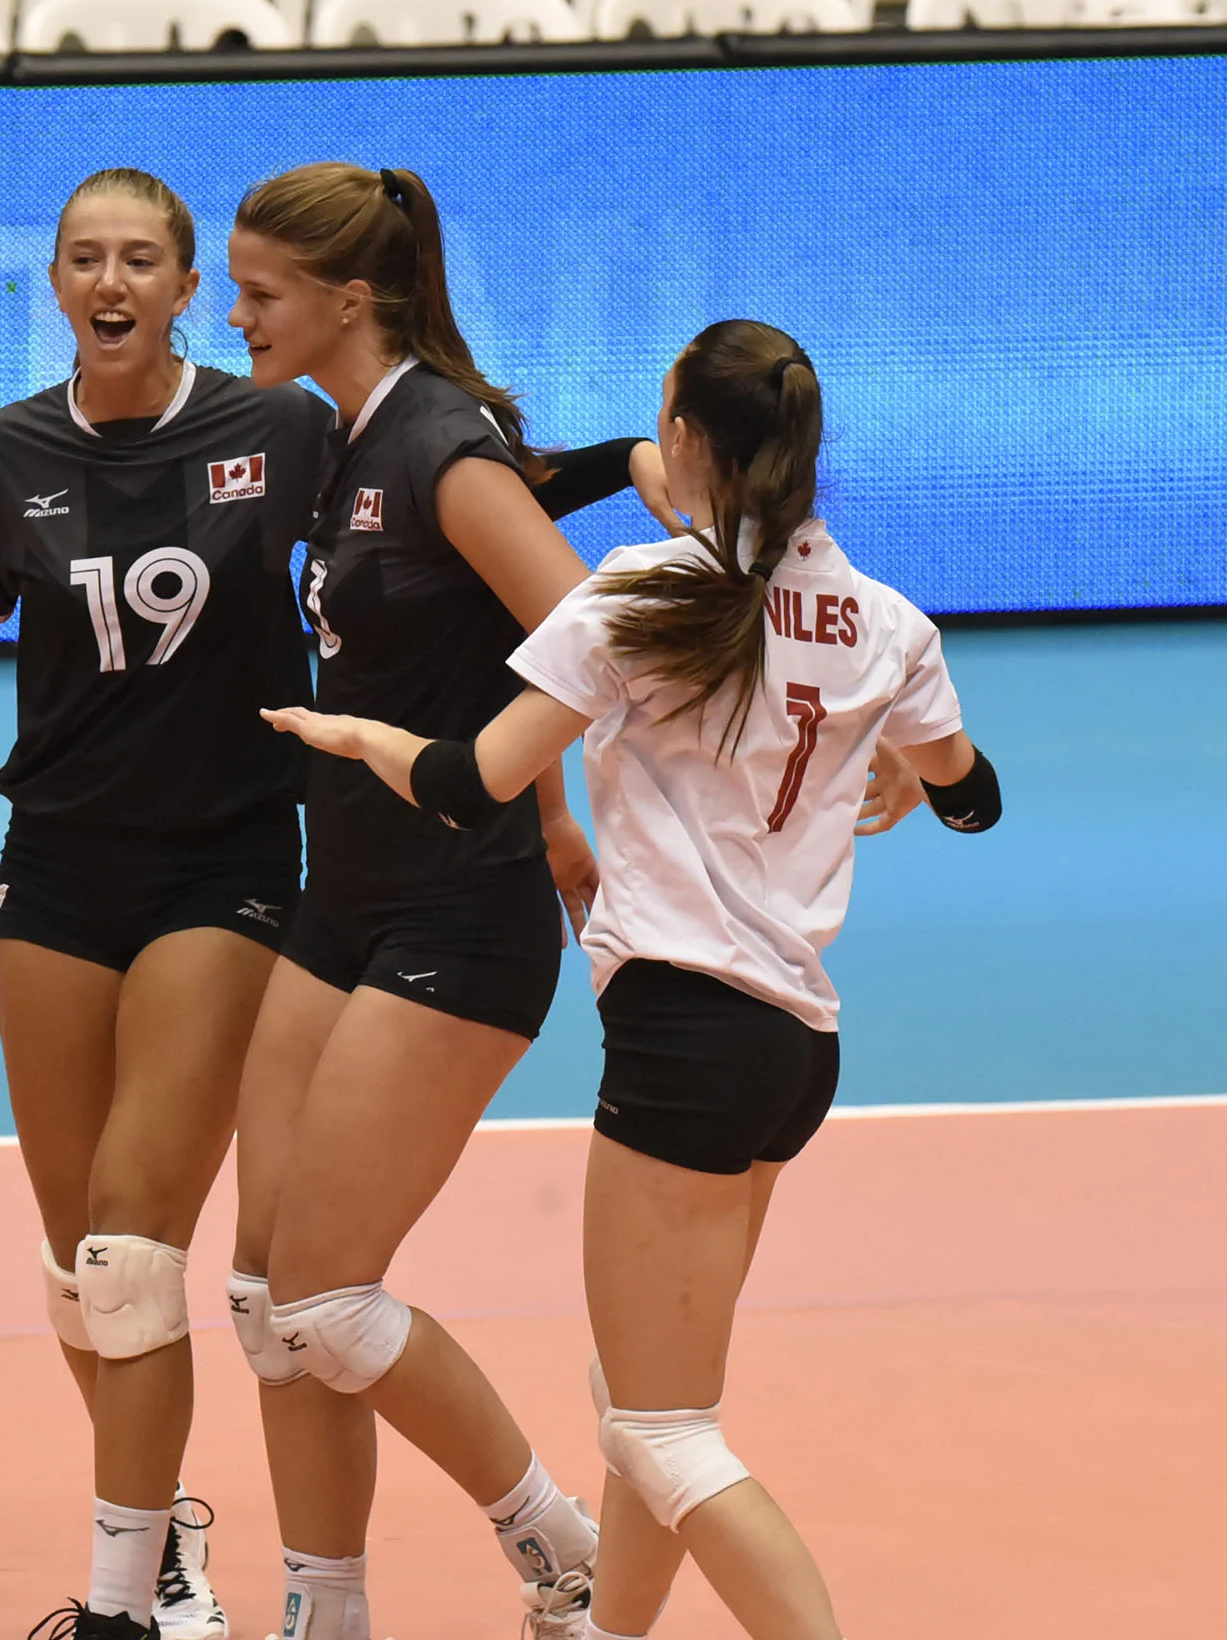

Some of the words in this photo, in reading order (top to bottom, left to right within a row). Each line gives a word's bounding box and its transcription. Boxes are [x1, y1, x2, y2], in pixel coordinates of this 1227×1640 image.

[212, 484, 263, 501] Canada
[70, 546, 211, 673] 19
[767, 681, 827, 834] 7
